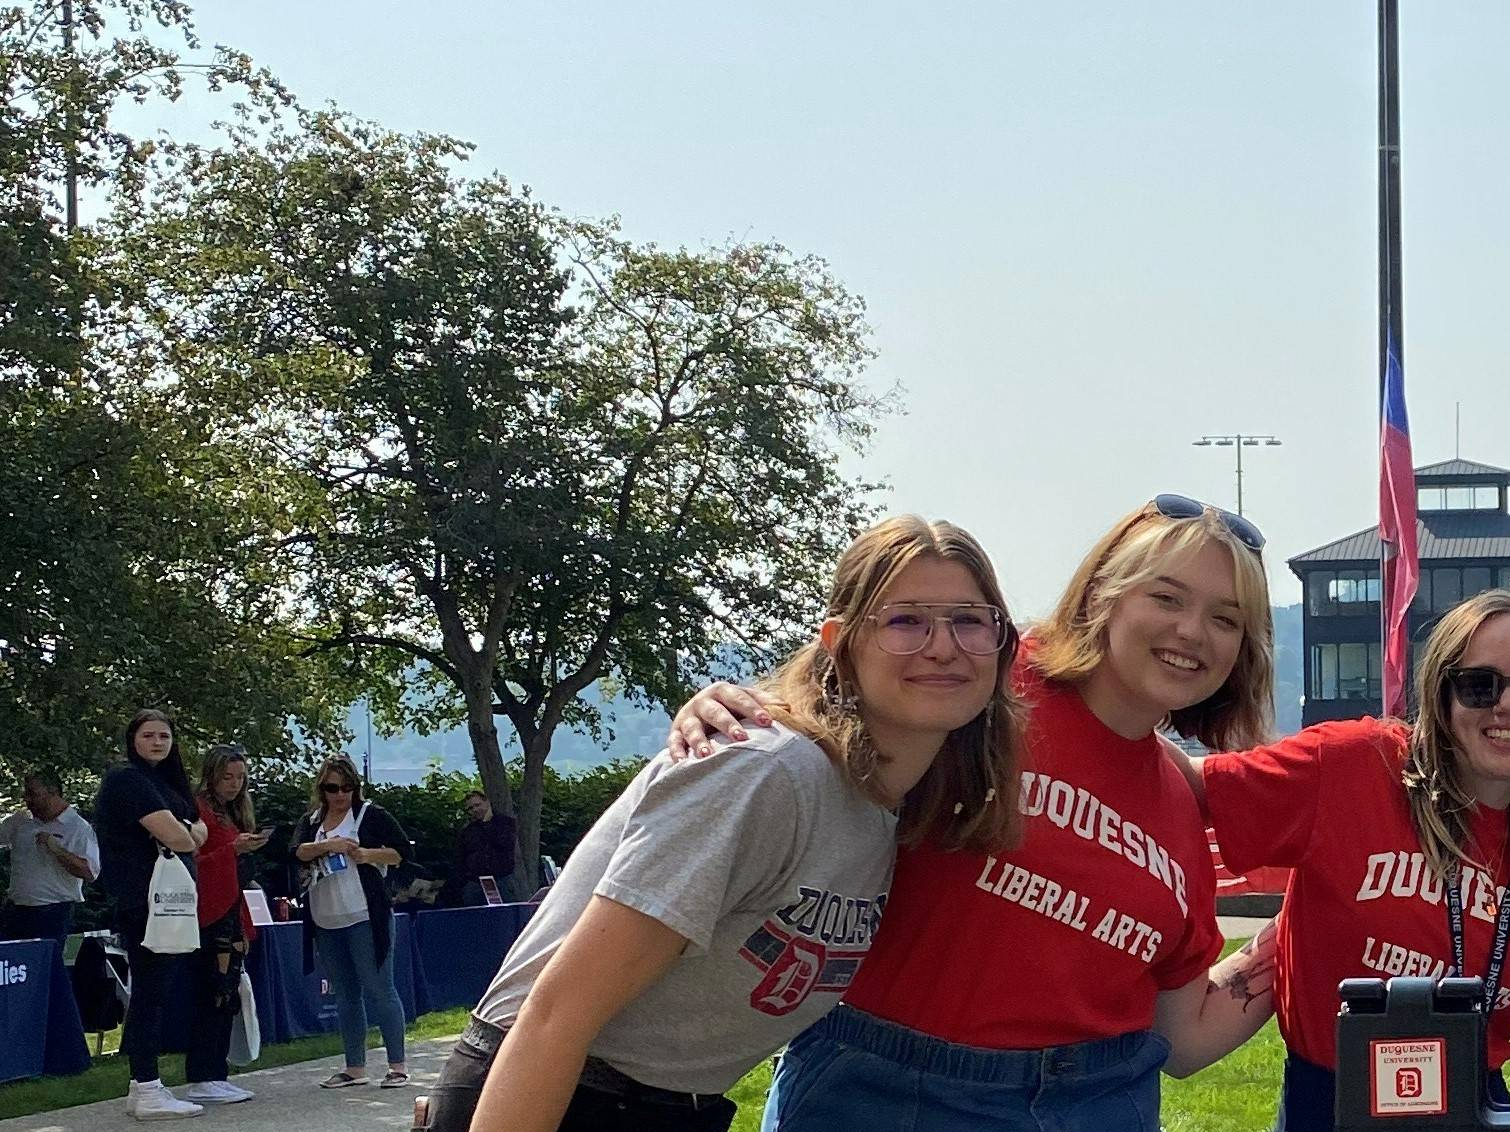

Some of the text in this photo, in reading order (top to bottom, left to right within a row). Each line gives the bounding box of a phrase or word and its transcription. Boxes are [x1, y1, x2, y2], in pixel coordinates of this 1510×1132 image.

[975, 855, 1163, 963] LIBERAL ARTS
[1380, 1045, 1436, 1055] DUQUESNE
